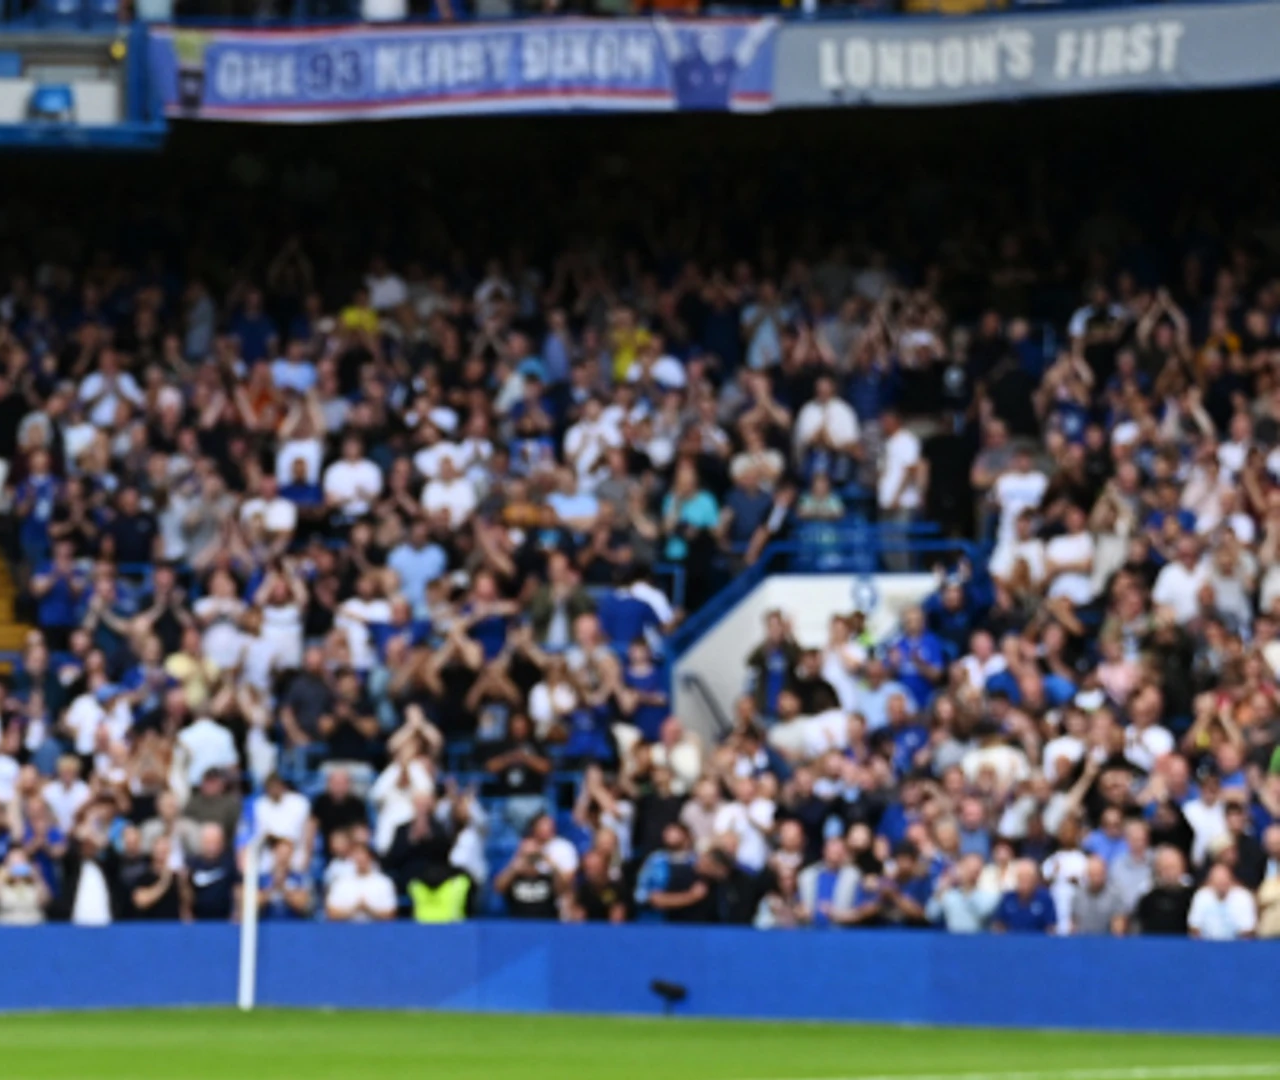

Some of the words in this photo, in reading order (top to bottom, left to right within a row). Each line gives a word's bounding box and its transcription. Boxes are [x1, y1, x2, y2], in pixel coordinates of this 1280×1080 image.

[305, 46, 366, 96] 93
[818, 27, 1035, 89] LONDON'S
[1054, 22, 1184, 77] FIRST
